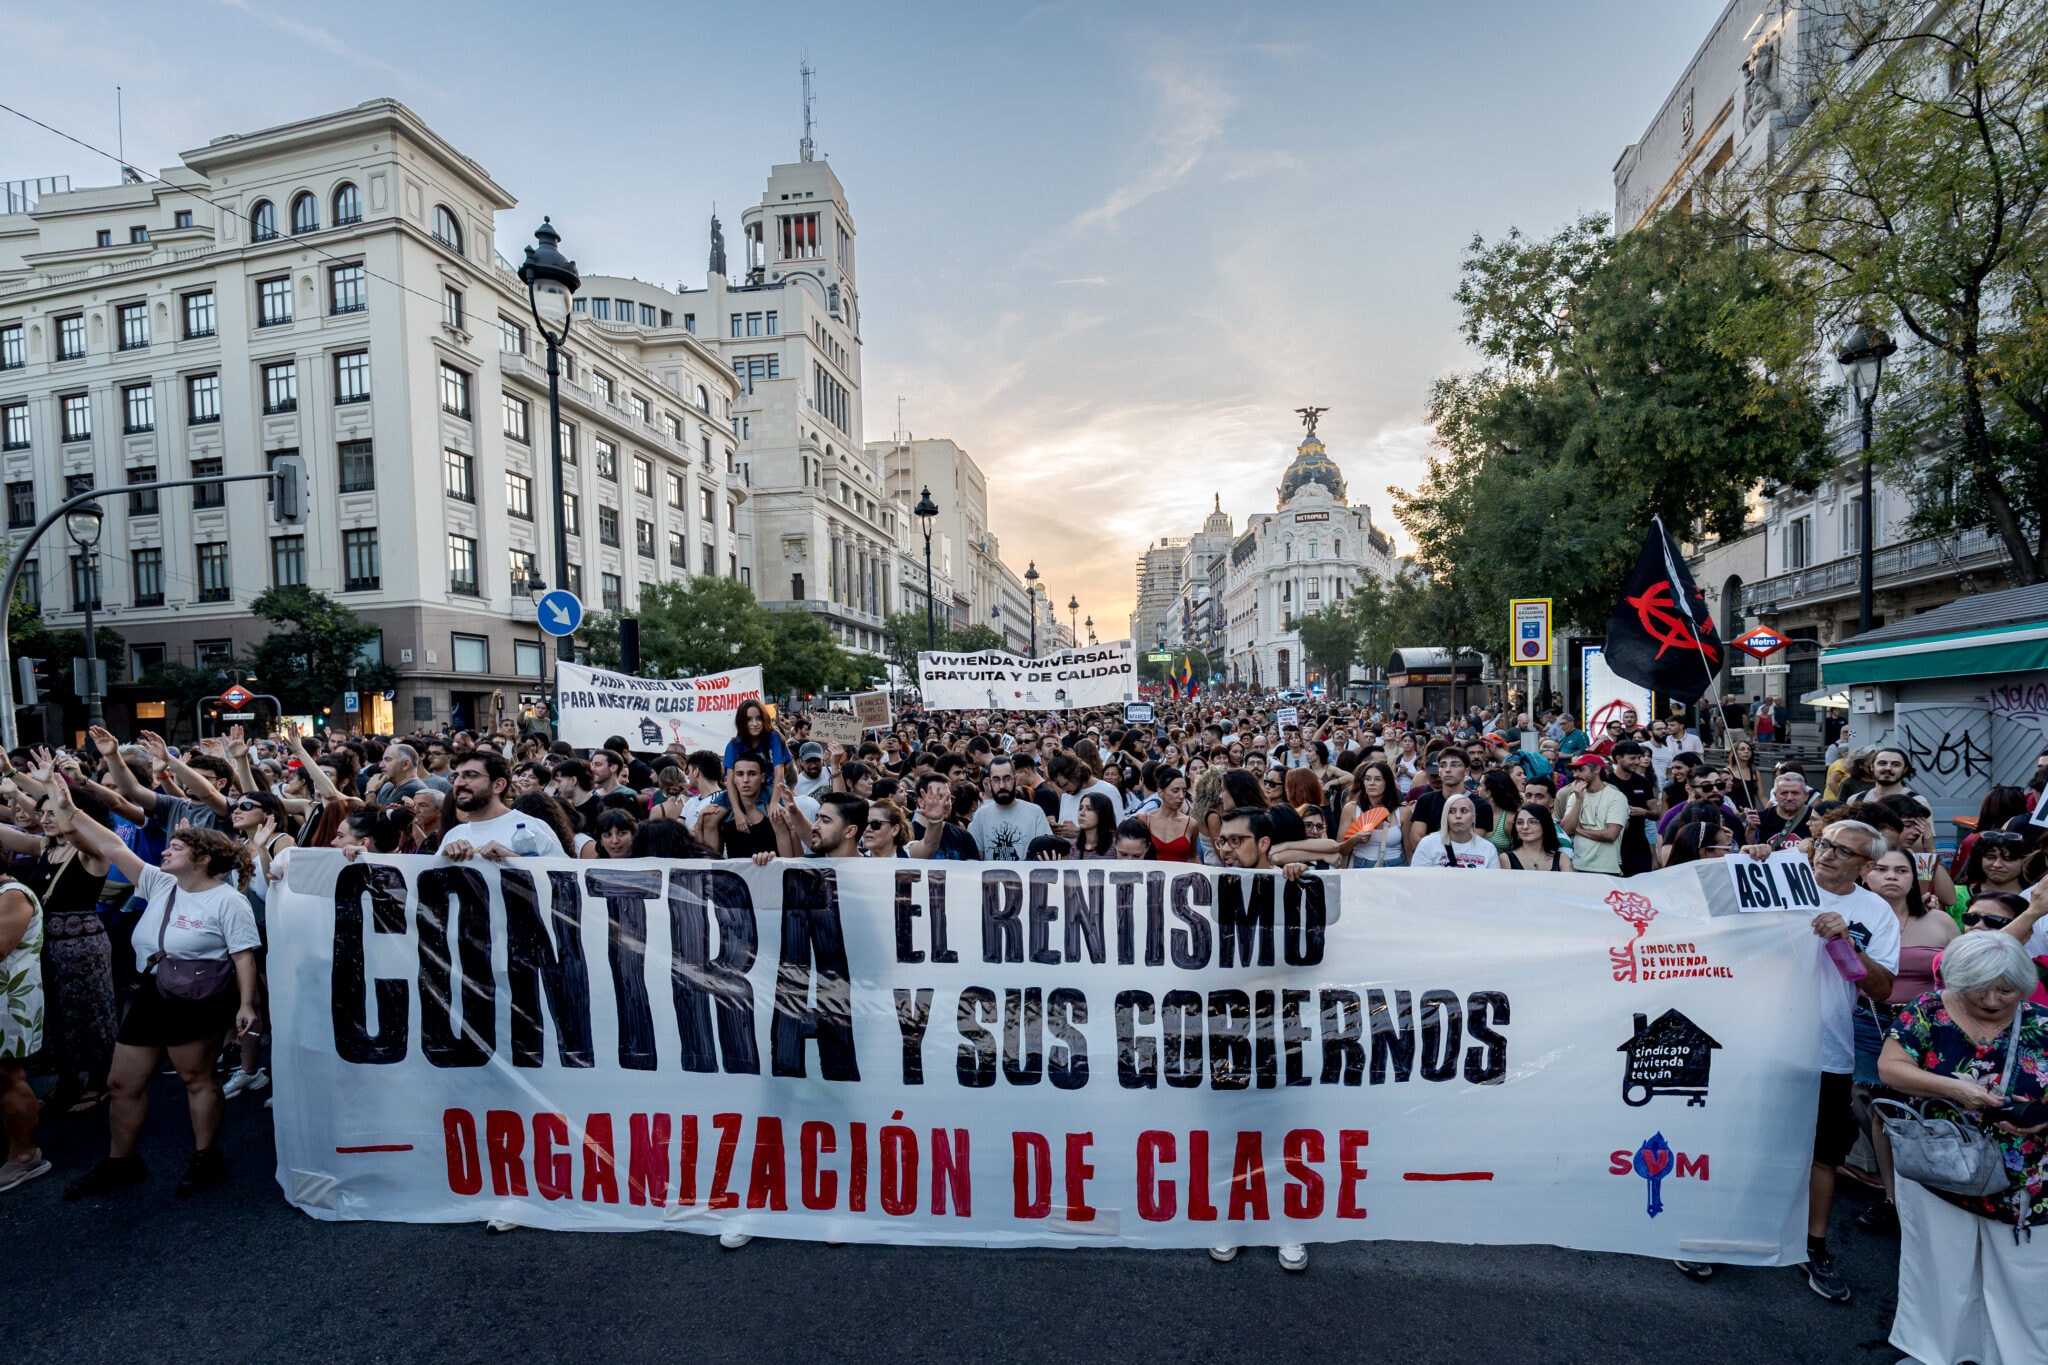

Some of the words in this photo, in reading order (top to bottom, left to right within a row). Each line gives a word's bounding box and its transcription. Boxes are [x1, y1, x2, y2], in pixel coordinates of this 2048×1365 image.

[1296, 513, 1328, 521] METROPOLIS
[1750, 638, 1776, 646] Metro
[929, 655, 1015, 667] VIVIENDA
[1018, 649, 1124, 669] UNIVERSAL,
[924, 671, 1006, 681] GRATUITA
[1010, 672, 1023, 682] Y
[1028, 672, 1052, 682] DE
[1057, 663, 1132, 681] CALIDAD
[590, 673, 626, 689] PARA
[626, 680, 674, 693] AYUSO,
[673, 682, 694, 691] UN
[694, 676, 730, 691] ÁTICO
[560, 691, 596, 709] PARA
[598, 692, 650, 711] NUESTRA
[655, 697, 694, 713] CLASE
[1781, 862, 1820, 907] NO
[1640, 943, 1696, 954] SINDICATO
[1642, 958, 1656, 967] DE
[1659, 956, 1708, 967] VIVIENDA
[332, 863, 861, 1082] CONTRA
[895, 869, 959, 964] EL
[981, 869, 1327, 970] RENTISMO
[1643, 970, 1656, 981] DE
[1658, 967, 1734, 980] CARABANCHEL
[892, 988, 935, 1085] Y
[956, 986, 1090, 1089] SUS
[1114, 988, 1511, 1091] GOBIERNOS
[1635, 1045, 1690, 1058] sindicato
[1633, 1057, 1684, 1069] vivienda
[443, 1107, 971, 1218] ORGANIZACIÓN
[1012, 1130, 1097, 1221] DE
[1136, 1128, 1369, 1221] CLASE
[1608, 1149, 1710, 1182] SVM
